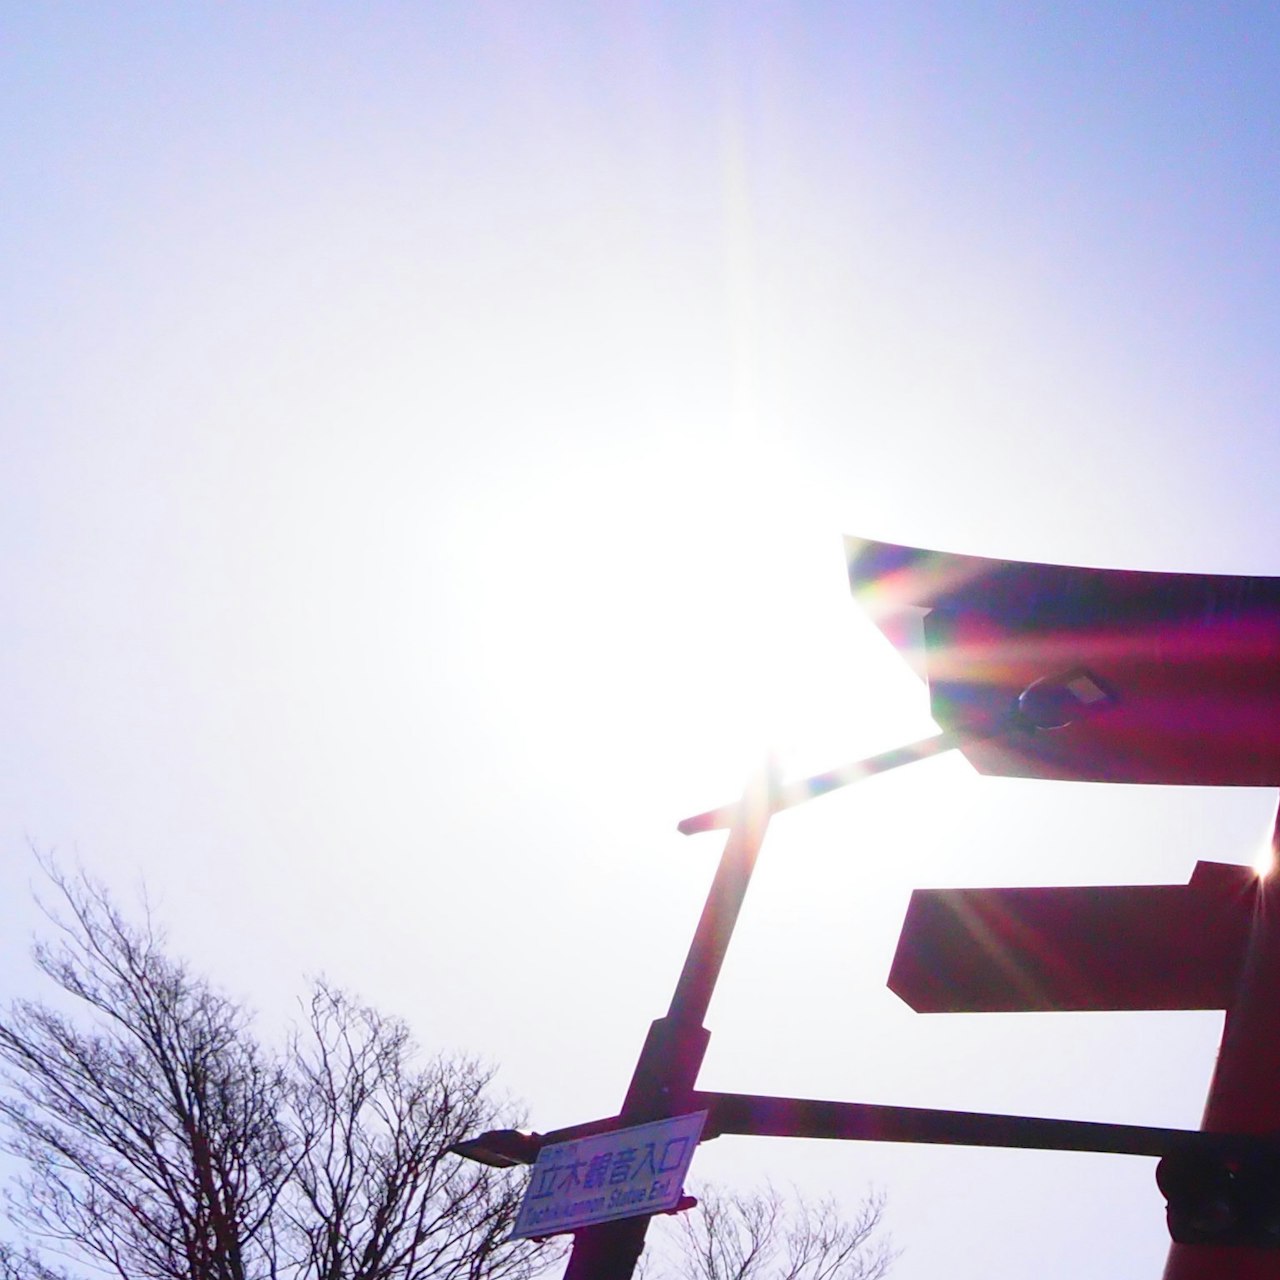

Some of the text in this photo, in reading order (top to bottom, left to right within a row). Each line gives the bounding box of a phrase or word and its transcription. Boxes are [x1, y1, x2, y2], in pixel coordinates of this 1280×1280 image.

[531, 1138, 690, 1199] 立木観音入口
